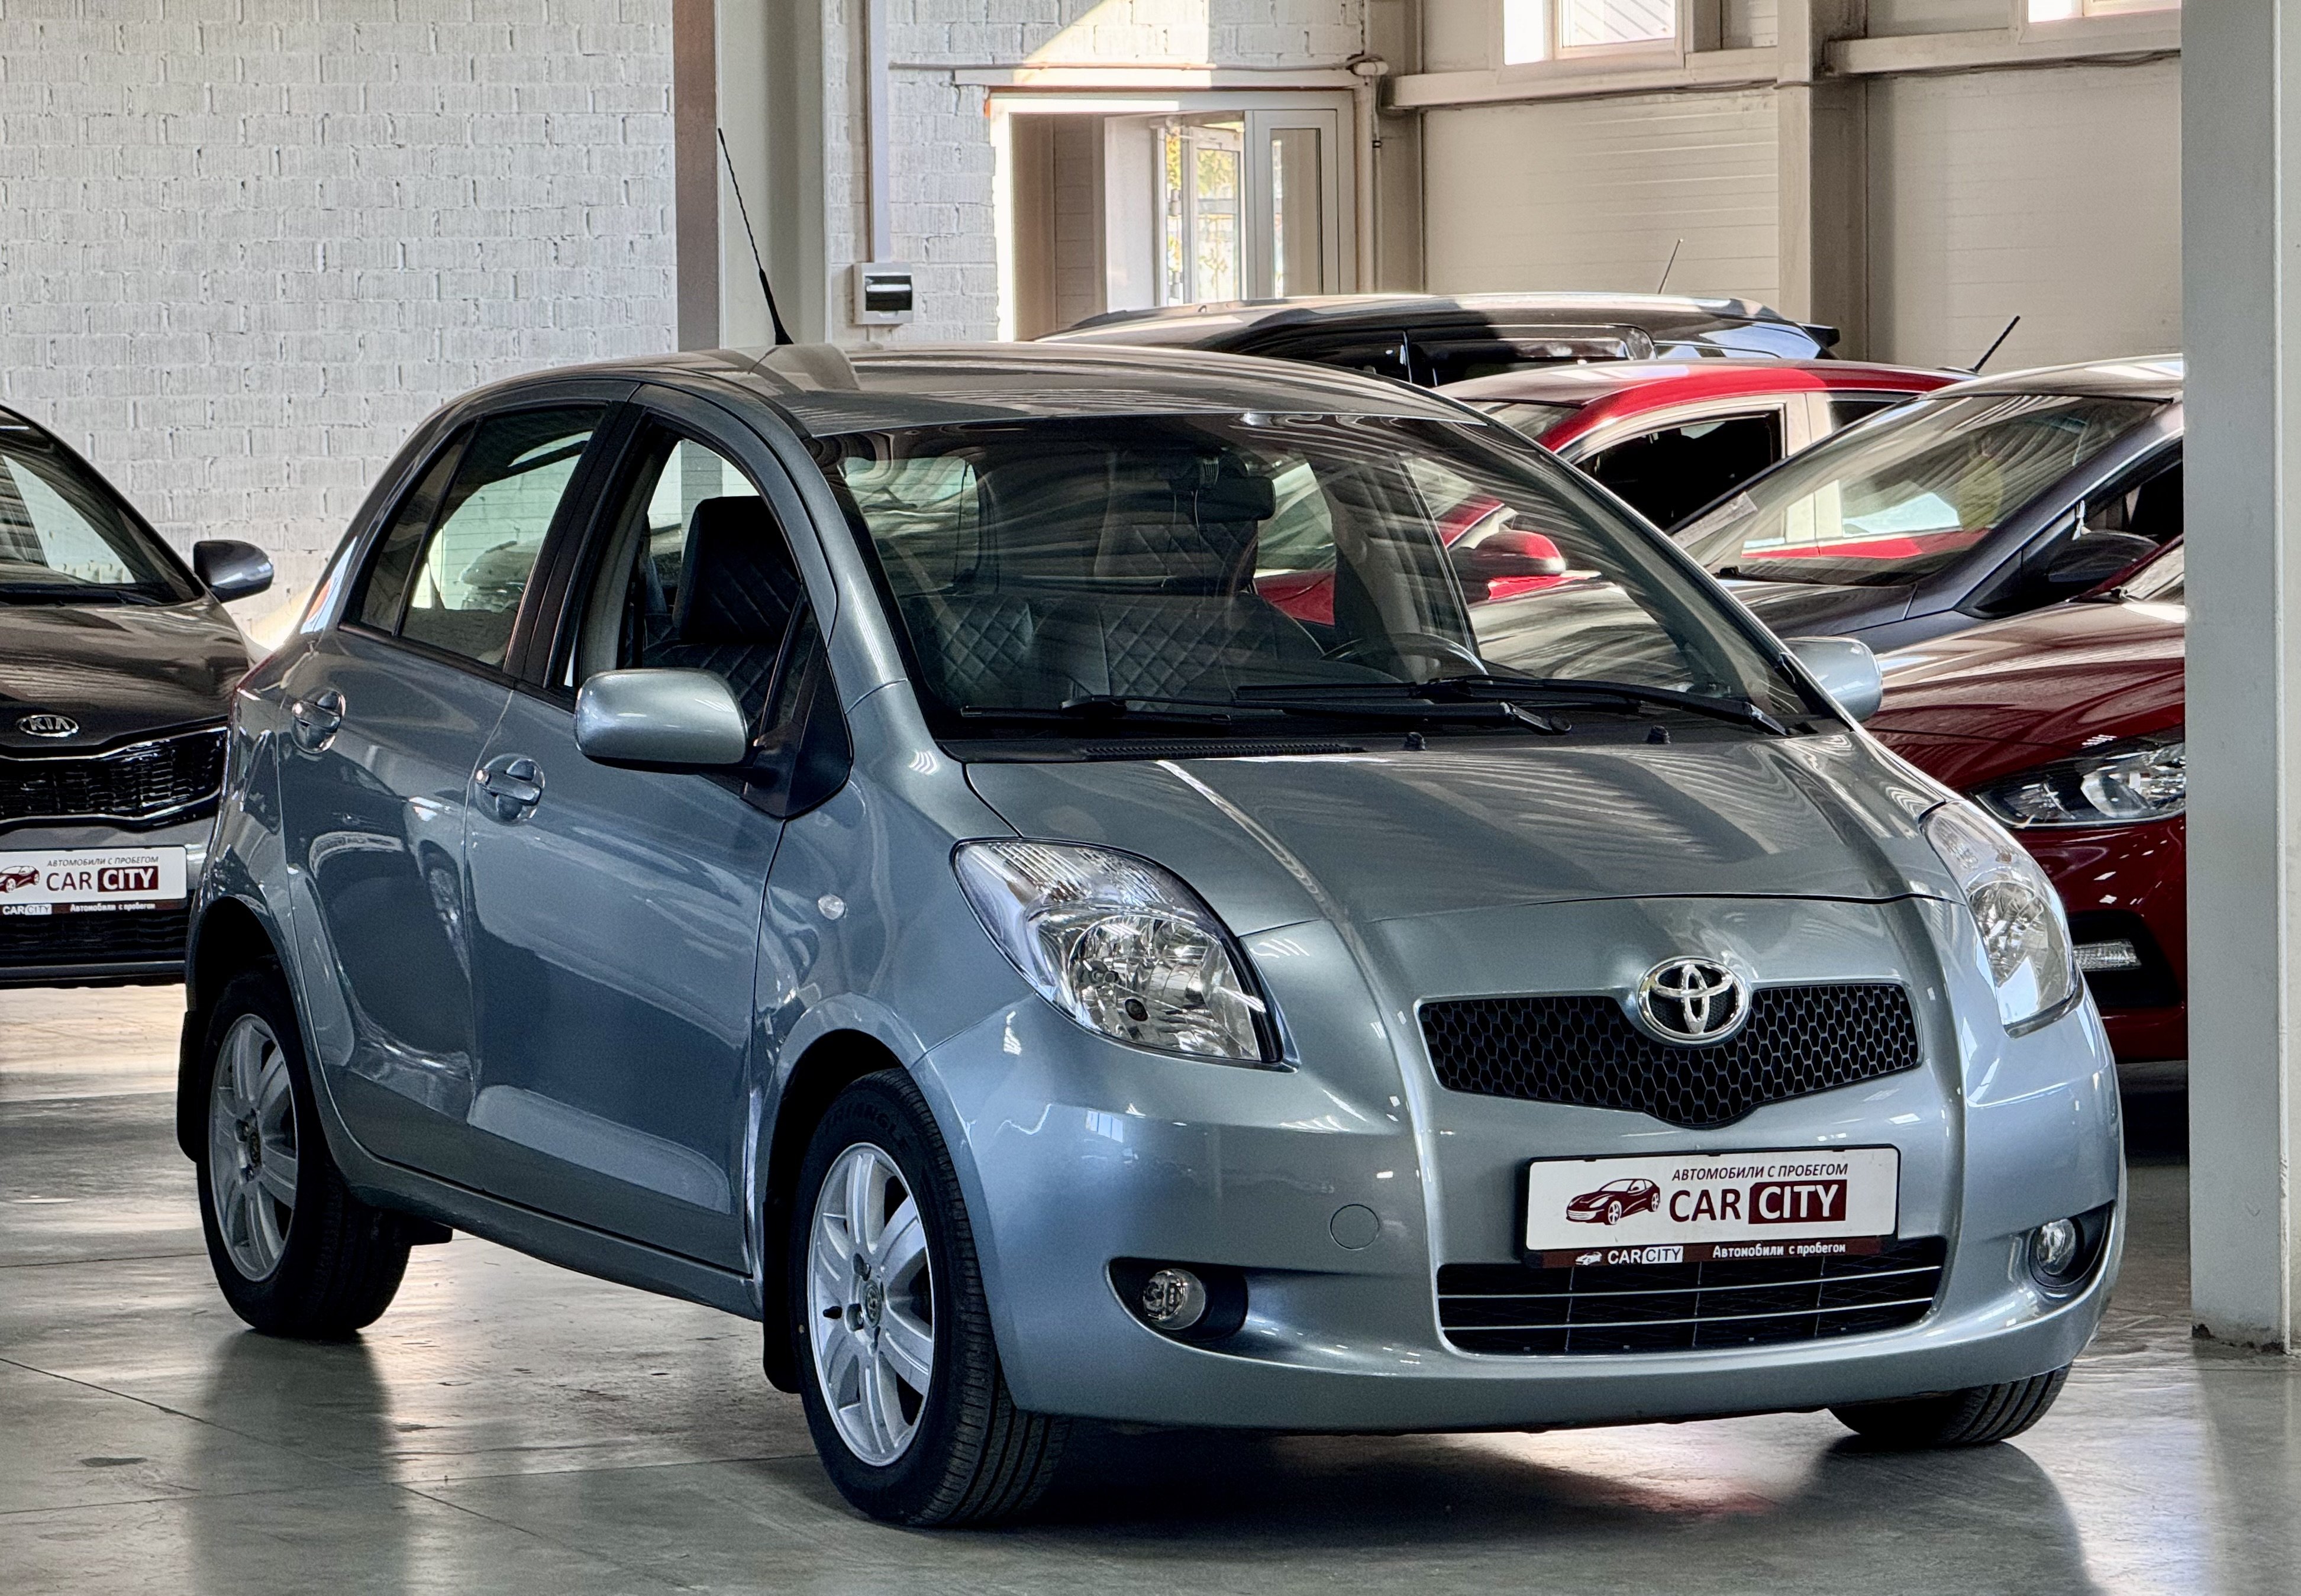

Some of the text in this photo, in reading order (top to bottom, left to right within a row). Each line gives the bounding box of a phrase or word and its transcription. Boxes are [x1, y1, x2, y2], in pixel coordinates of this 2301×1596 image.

[30, 718, 70, 731] KIA
[47, 858, 105, 867] АВТОМОБИЛИ
[46, 868, 154, 891] CAR CITY
[825, 1101, 912, 1153] TRIANGLE
[1671, 1163, 1848, 1181] АВТОМОБИЛИ С ПРОБЕГОМ
[1669, 1184, 1839, 1222] CAR CITY
[1713, 1243, 1784, 1258] Автомобили
[1797, 1242, 1846, 1257] пробегом
